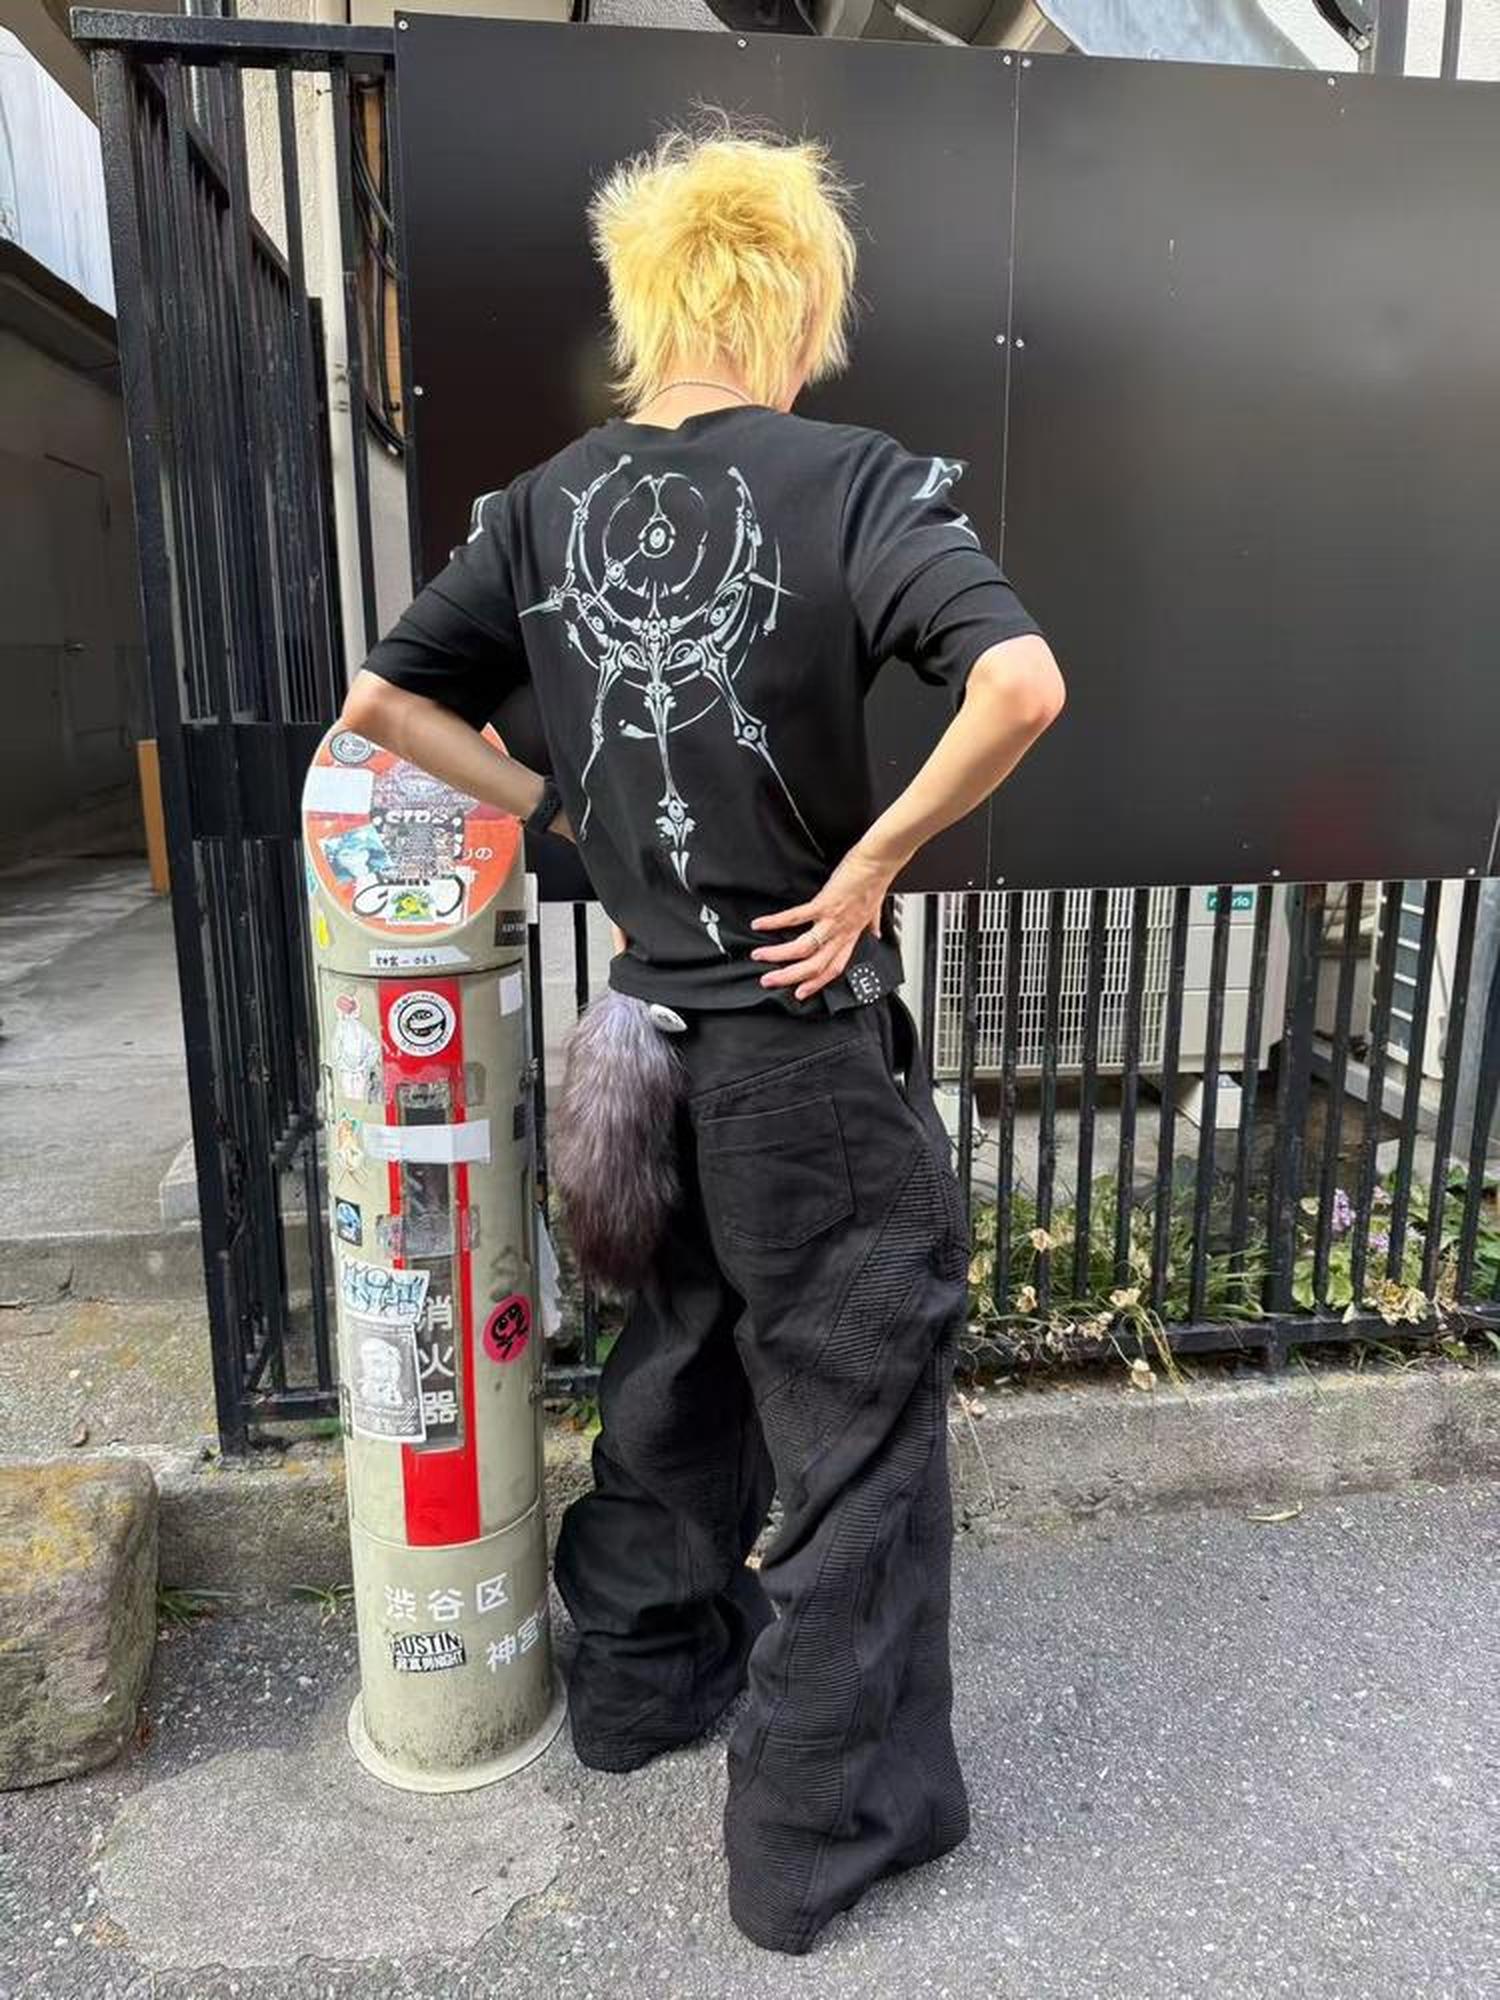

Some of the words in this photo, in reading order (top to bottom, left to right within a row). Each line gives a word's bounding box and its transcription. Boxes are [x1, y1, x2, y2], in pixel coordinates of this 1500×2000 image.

[416, 1295, 459, 1426] 消火器
[384, 1572, 509, 1623] 渋谷区
[394, 1632, 460, 1655] AUSTIN
